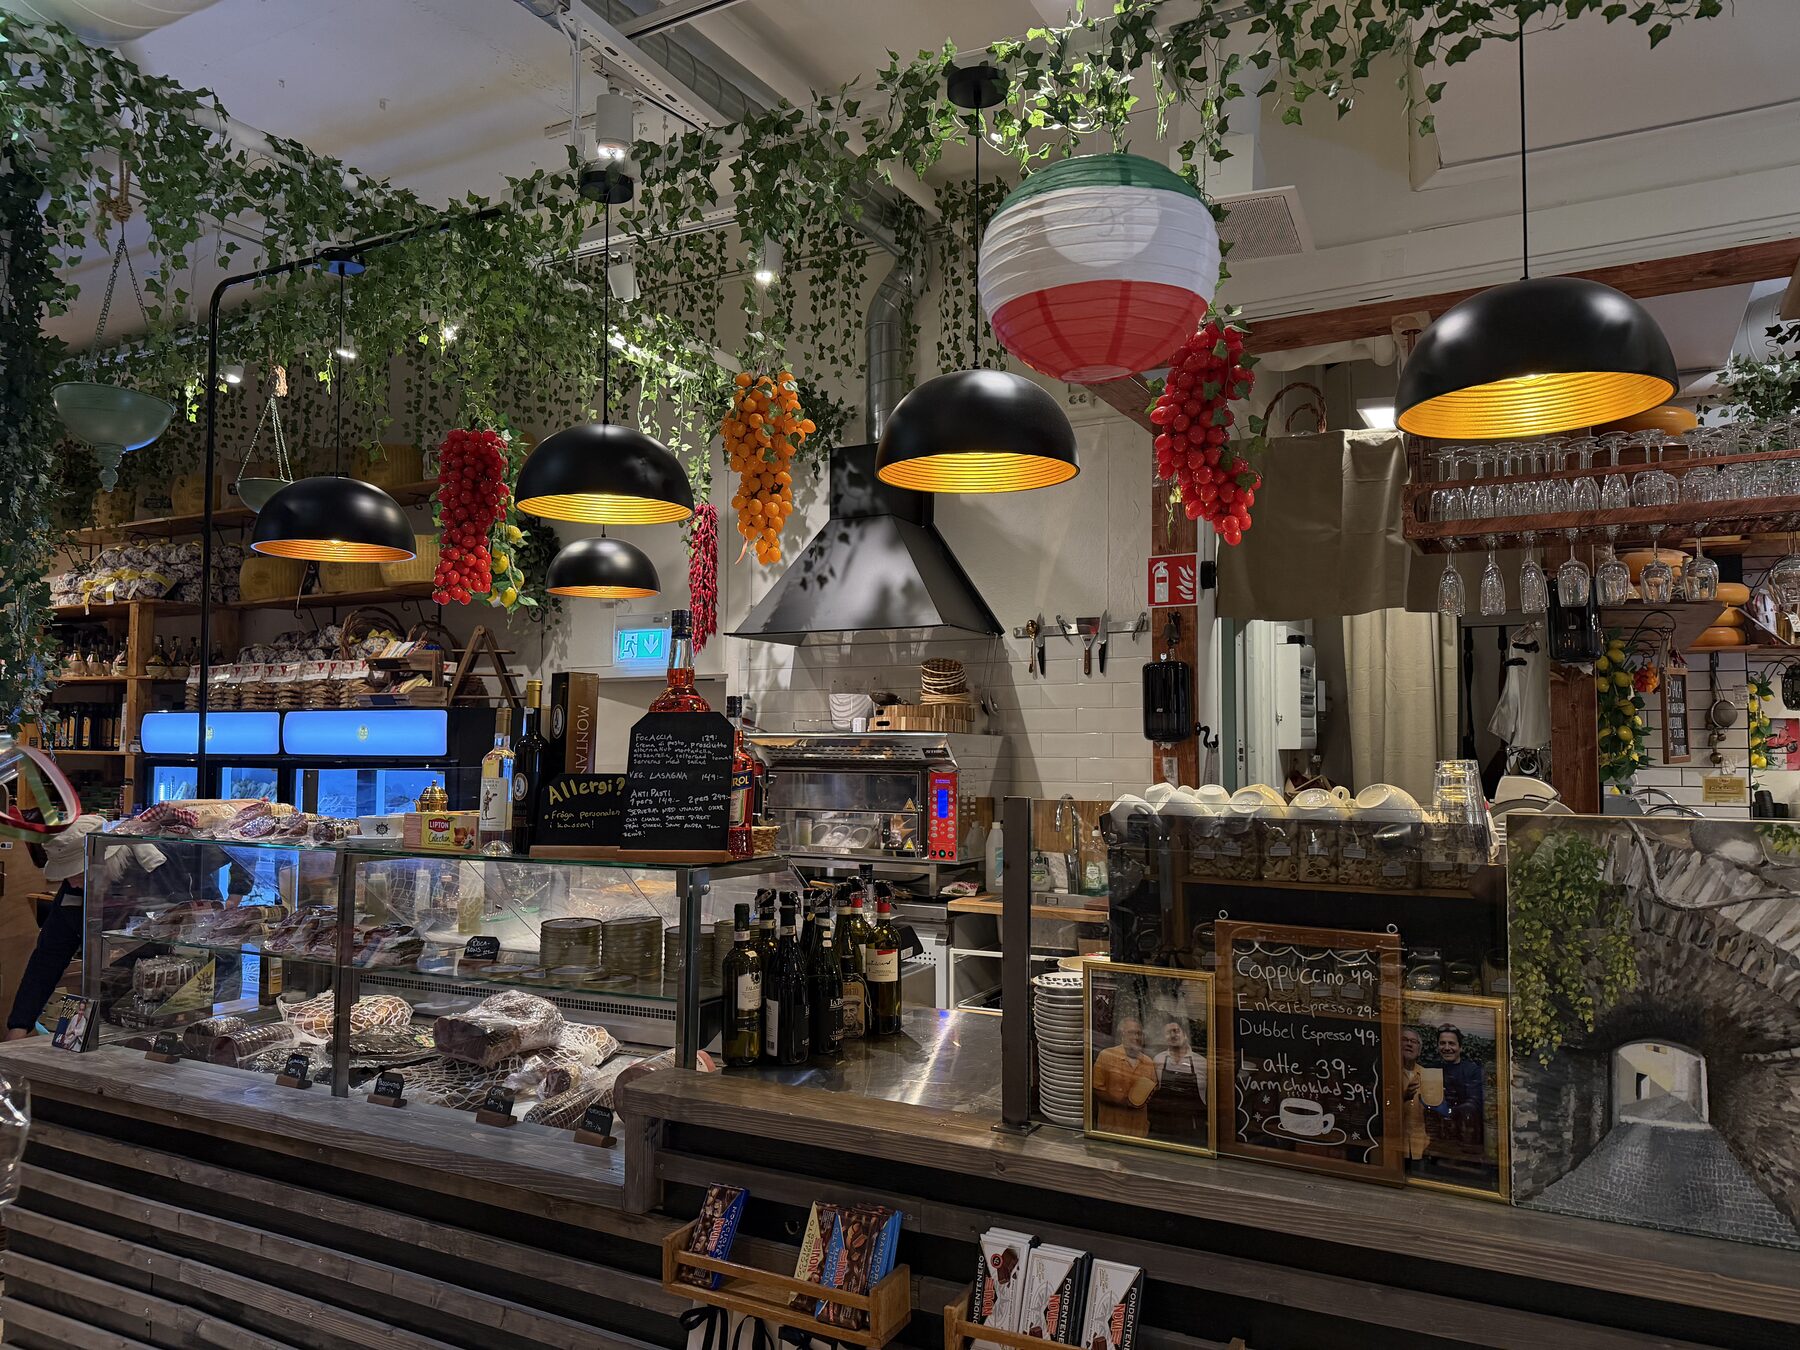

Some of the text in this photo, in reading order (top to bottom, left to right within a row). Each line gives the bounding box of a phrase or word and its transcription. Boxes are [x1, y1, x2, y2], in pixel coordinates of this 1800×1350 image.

[649, 771, 688, 780] LASAGNA
[732, 775, 750, 786] ROL
[548, 776, 626, 806] Allergi?
[429, 820, 449, 828] LIPTON
[551, 808, 621, 822] Fråga personalen
[1237, 956, 1344, 992] Cappuccino
[1237, 993, 1291, 1014] Enkel
[1294, 1001, 1353, 1018] Espresso
[1239, 1018, 1295, 1040] Dubbel
[1302, 1024, 1352, 1046] Espresso
[1241, 1048, 1303, 1075] Latte
[797, 1220, 814, 1278] OCCIOLATO
[823, 1227, 840, 1286] NDORLATO
[972, 1256, 985, 1324] ONDENTENERO
[982, 1289, 994, 1316] NOVI
[1047, 1295, 1060, 1320] NOVI
[1059, 1278, 1072, 1344] FONDENTENE
[1111, 1304, 1126, 1331] NOVI
[1124, 1287, 1138, 1350] FONDENTEN
